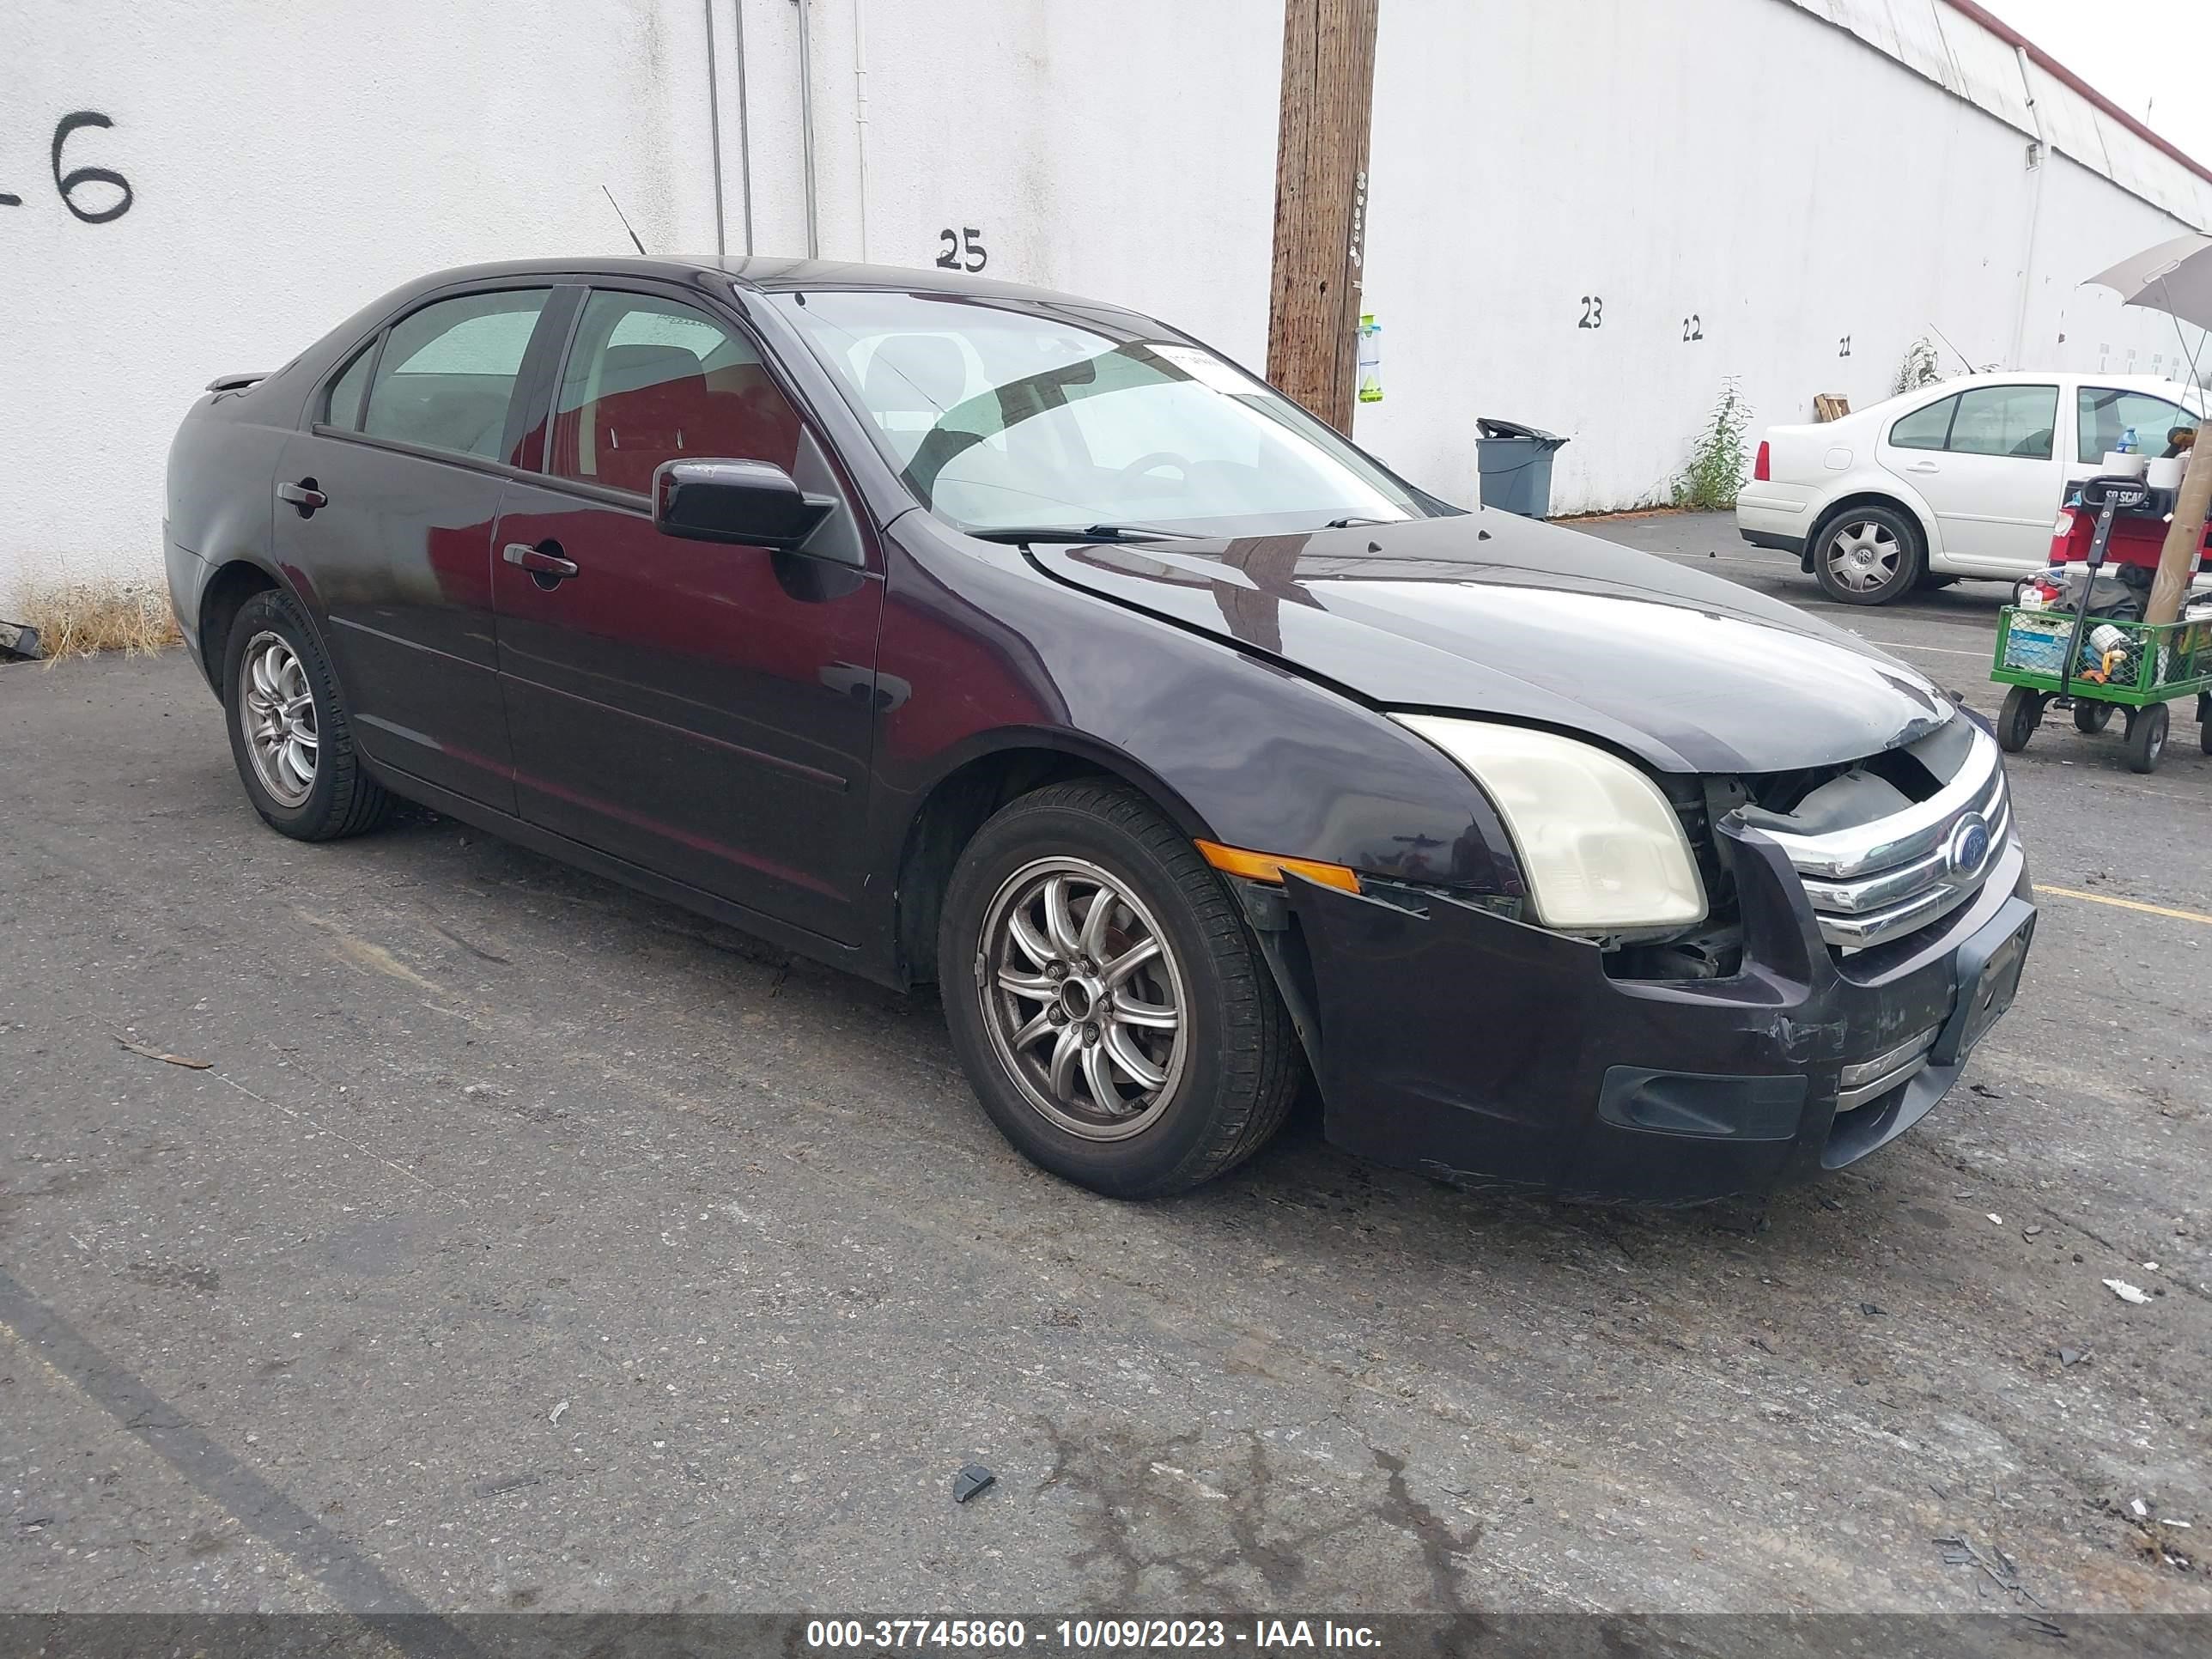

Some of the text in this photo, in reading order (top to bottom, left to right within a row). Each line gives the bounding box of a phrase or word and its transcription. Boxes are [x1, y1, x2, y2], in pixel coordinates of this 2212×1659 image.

[936, 227, 988, 273] 25
[1579, 297, 1602, 329] 23
[1683, 314, 1704, 343] 22
[1838, 336, 1850, 357] 21
